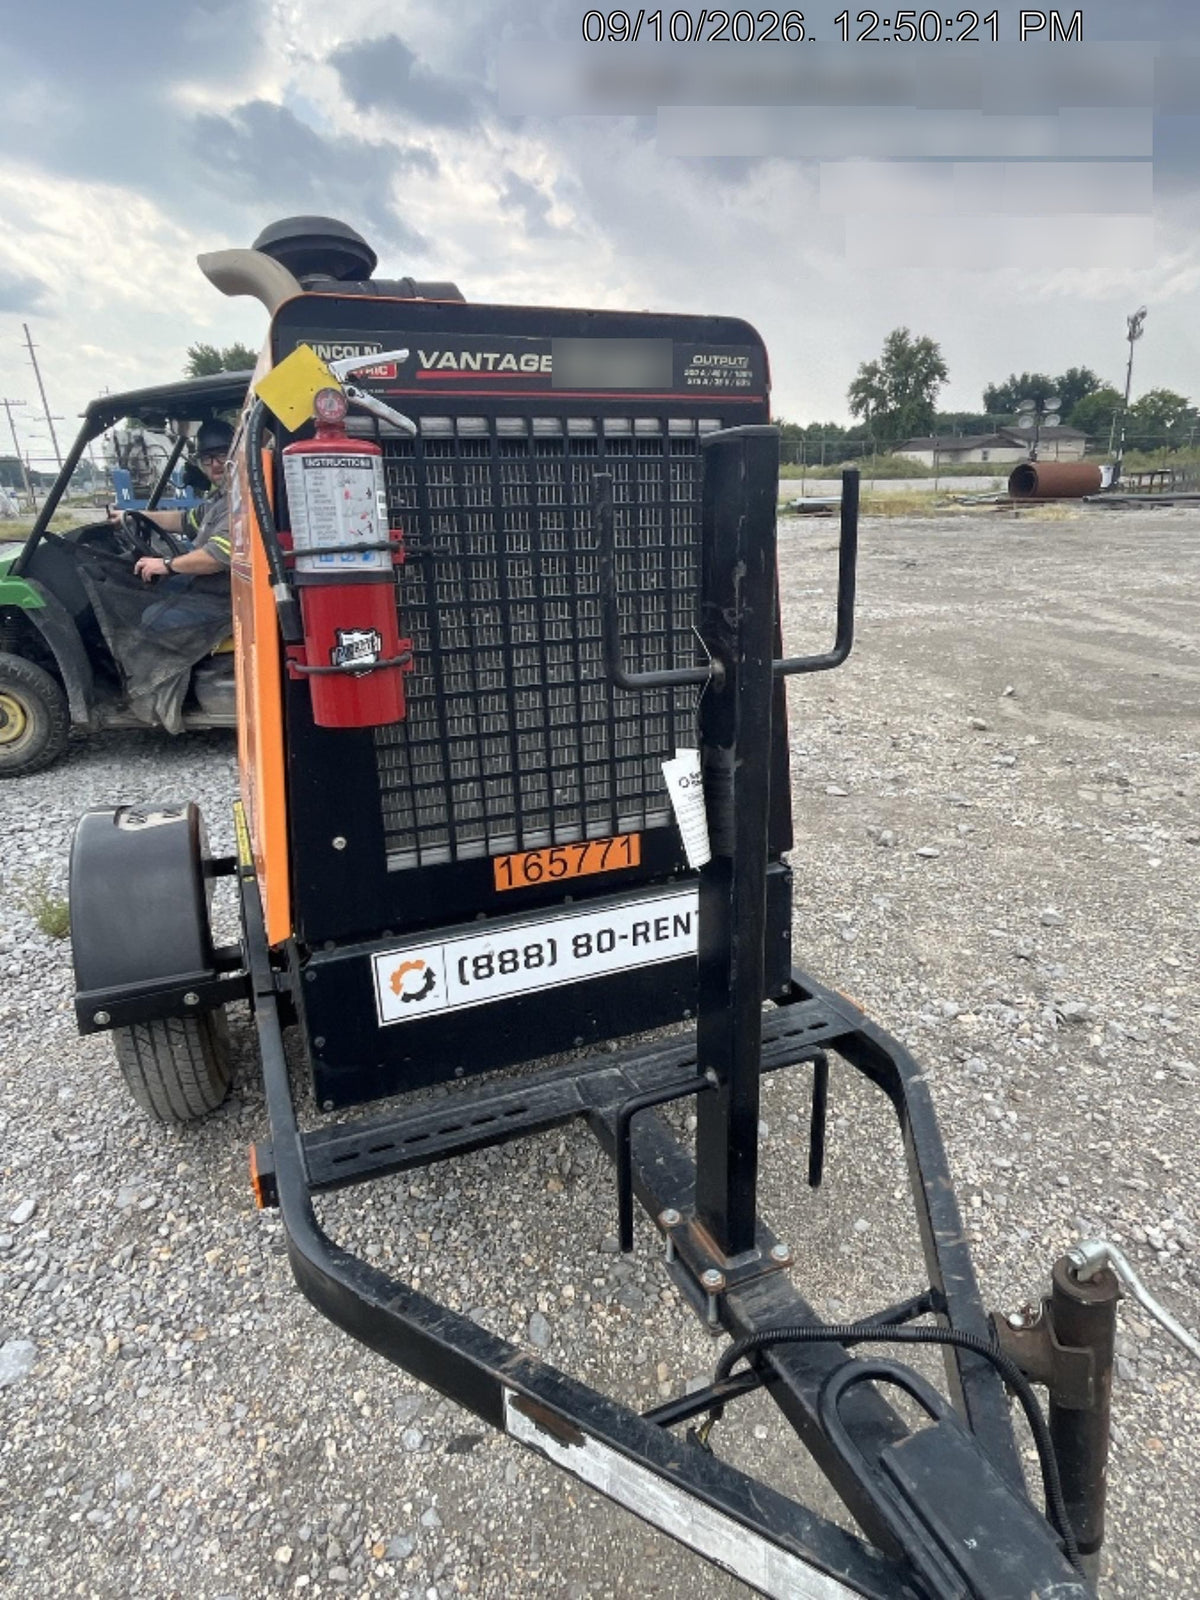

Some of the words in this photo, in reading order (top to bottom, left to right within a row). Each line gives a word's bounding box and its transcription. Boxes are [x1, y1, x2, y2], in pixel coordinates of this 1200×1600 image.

[312, 344, 377, 360] INCOLN
[417, 350, 552, 372] VANTAGE
[692, 354, 746, 366] OUTPUT
[499, 834, 634, 887] 165771
[458, 938, 558, 986] (888)
[571, 909, 699, 959] 80-REN
